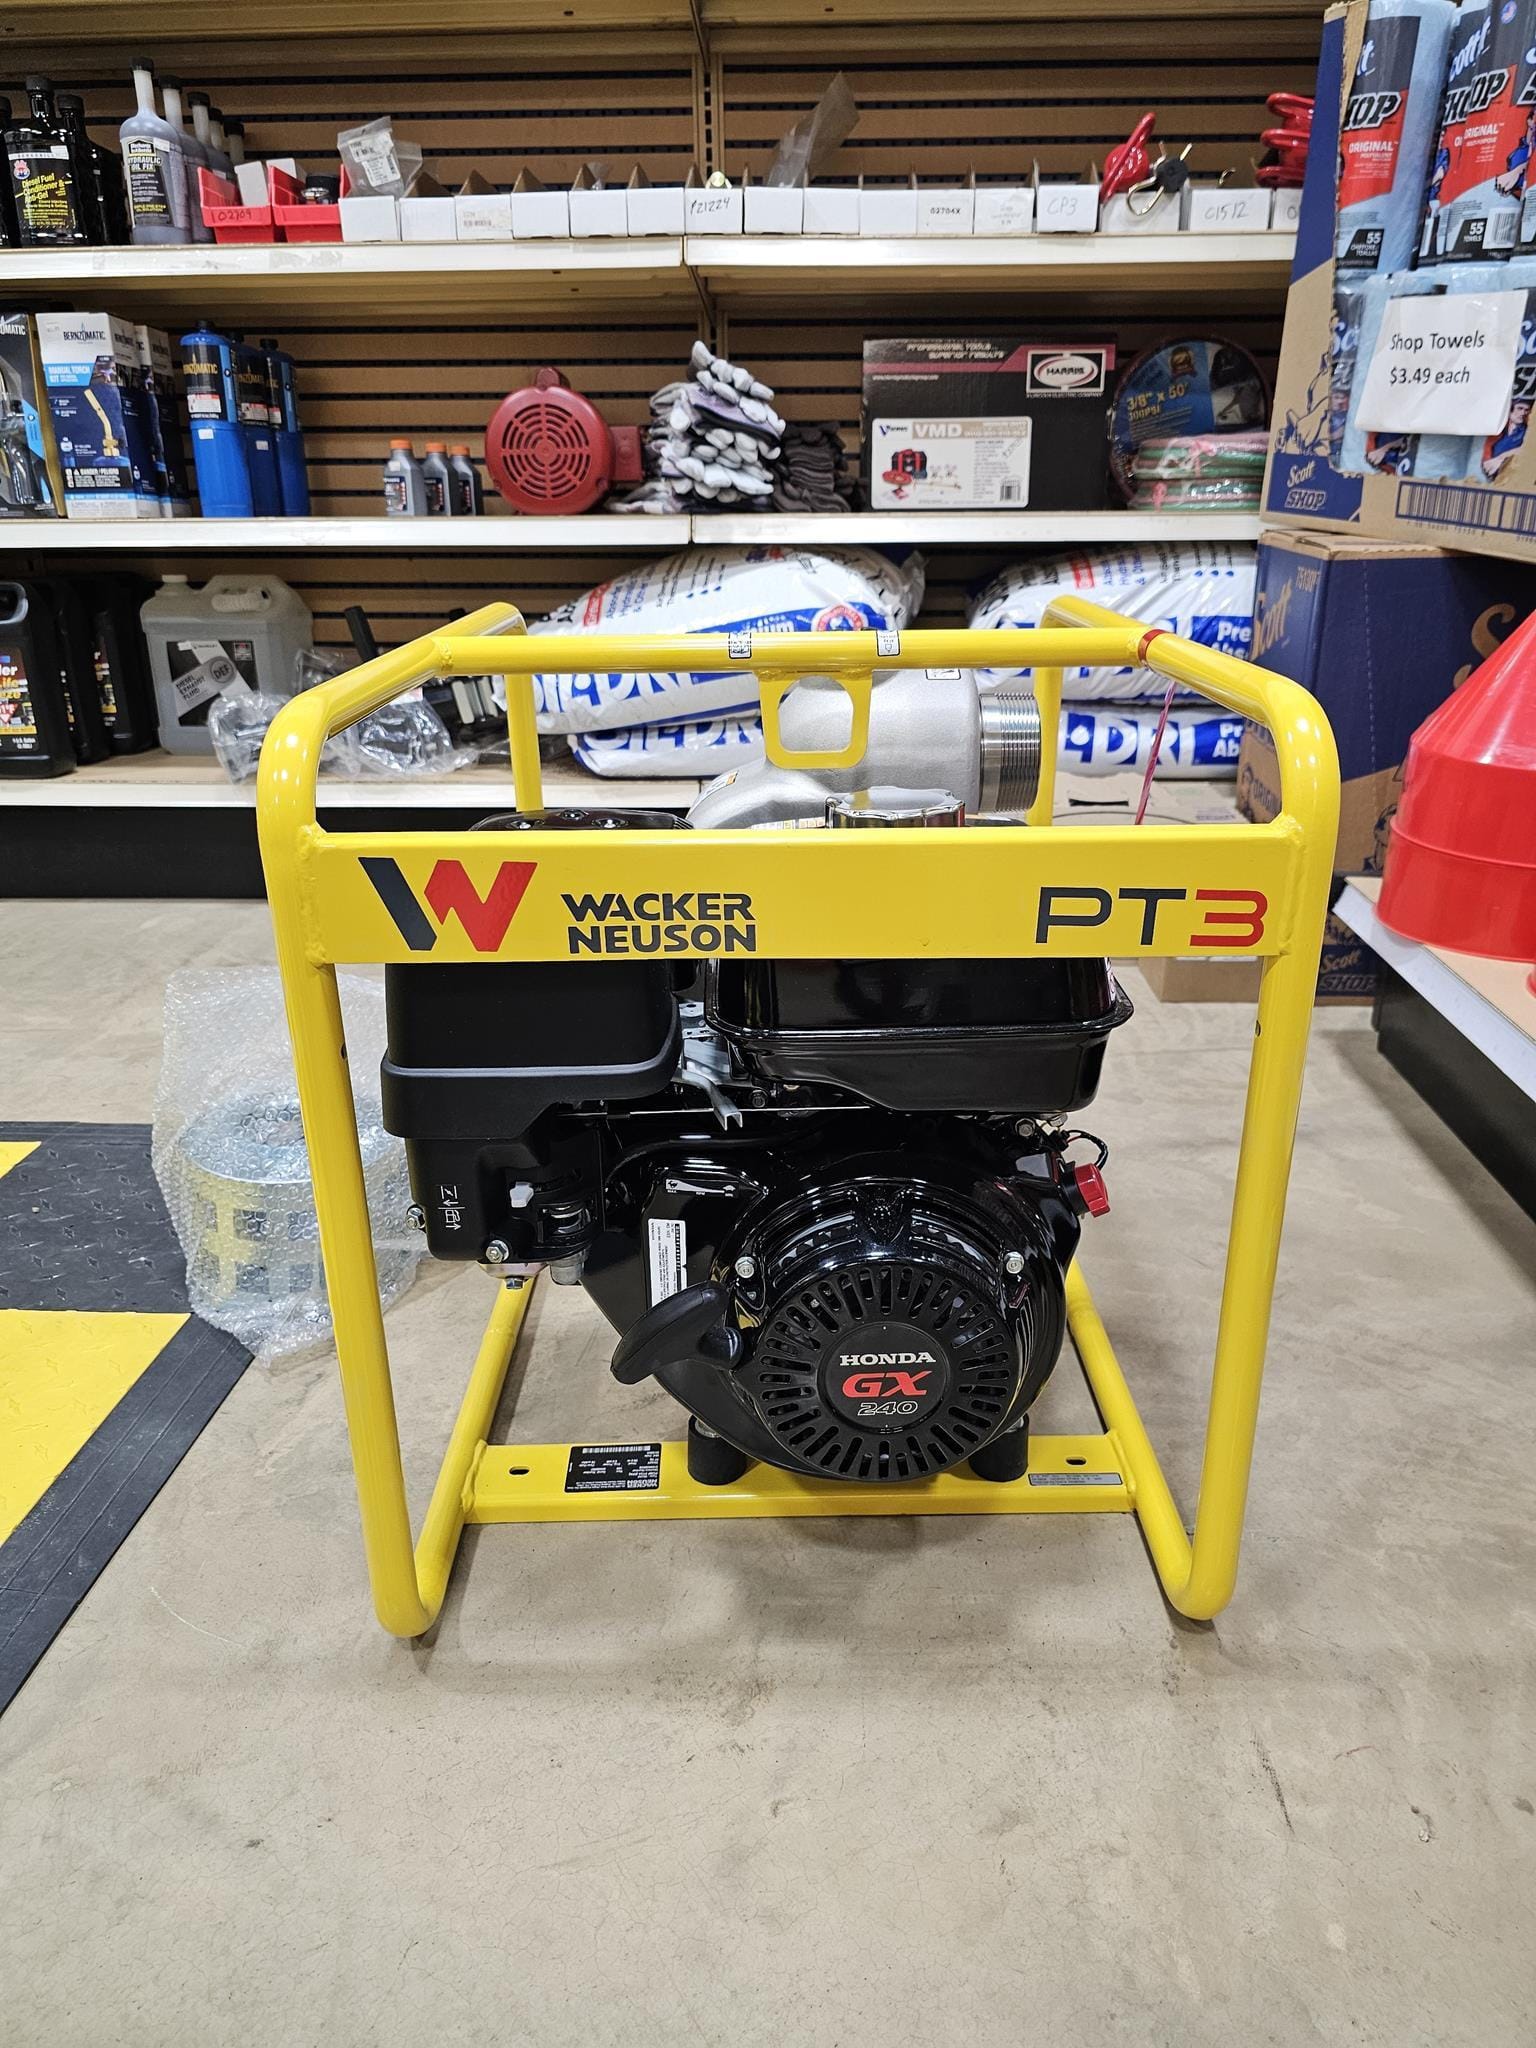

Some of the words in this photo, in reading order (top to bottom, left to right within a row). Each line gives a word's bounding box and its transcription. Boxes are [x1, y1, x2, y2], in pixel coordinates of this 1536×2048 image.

[1349, 141, 1394, 154] ORIGINAL
[1469, 222, 1484, 235] 55
[1366, 232, 1381, 245] 55
[63, 327, 106, 342] BERNZOMATIC
[1389, 333, 1423, 353] Shop
[1430, 330, 1485, 349] Towels
[1046, 366, 1084, 376] HARRIS
[1389, 365, 1430, 385] $3.49
[1435, 366, 1470, 384] each
[915, 424, 963, 438] VMD
[1286, 462, 1316, 488] Scott
[1284, 488, 1327, 510] SHOP
[213, 664, 230, 680] DEF
[560, 893, 757, 921] WACKER
[1035, 886, 1268, 947] PT3
[568, 924, 757, 954] NEUSON
[1320, 949, 1361, 974] Scott
[1318, 974, 1377, 992] SHOP
[839, 1352, 936, 1366] HONDA
[842, 1370, 933, 1398] GX
[857, 1400, 919, 1417] 240
